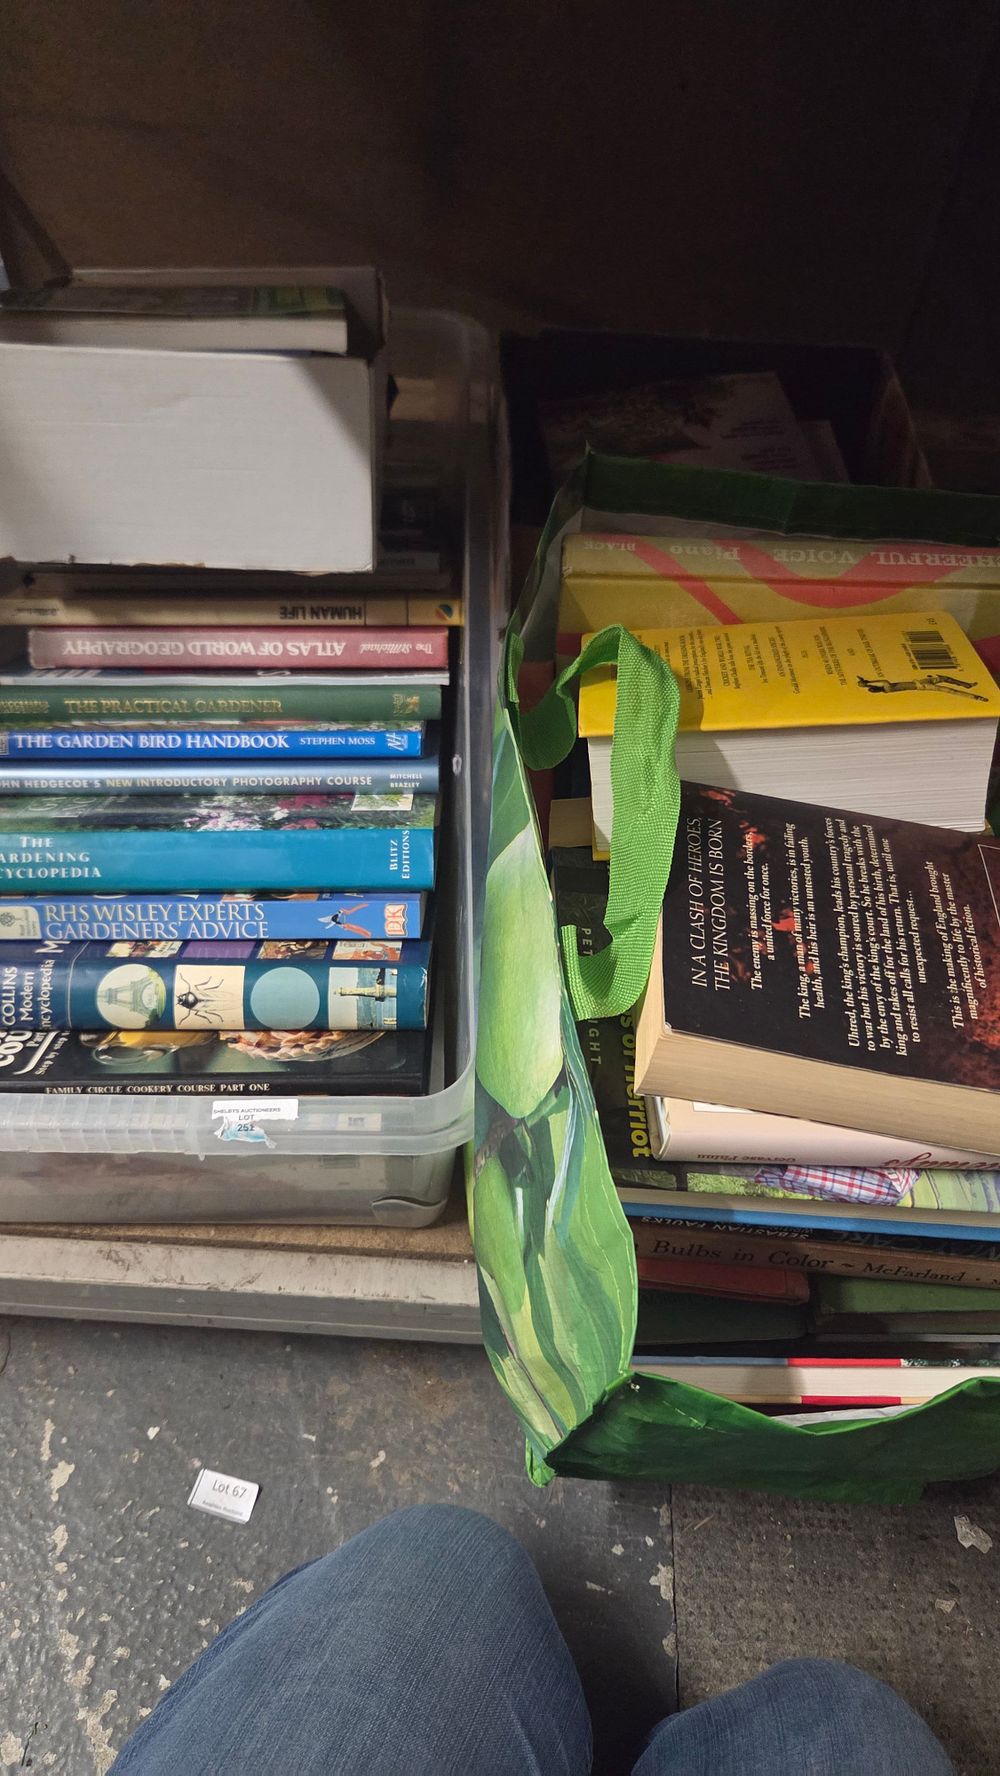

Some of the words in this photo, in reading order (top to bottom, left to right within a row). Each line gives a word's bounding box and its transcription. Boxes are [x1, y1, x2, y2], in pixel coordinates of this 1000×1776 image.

[583, 540, 636, 551] BLACK
[670, 545, 740, 560] Piano
[773, 549, 857, 564] VOICE
[279, 605, 306, 620] LIFE
[307, 605, 363, 620] HUMAN
[62, 640, 184, 656] GEOGRAPHY
[188, 641, 258, 656] WORLD
[259, 641, 284, 656] OF
[287, 641, 346, 656] ATLAS
[416, 643, 434, 655] The
[64, 698, 98, 713] THE
[100, 699, 192, 713] PRACTICAL
[195, 699, 283, 713] GARDENER
[15, 735, 53, 748] THE
[57, 735, 134, 748] GARDEN
[138, 735, 181, 748] BIRD
[186, 734, 290, 748] HANDBOOK
[300, 737, 345, 745] STEPHEN
[348, 737, 376, 745] MOSS
[0, 779, 20, 788] HN
[25, 779, 101, 788] HEDGECOE'S
[106, 779, 132, 788] NEW
[137, 778, 226, 787] INTRODUCTORY
[233, 777, 322, 787] PHOTOGRAPHY
[327, 776, 372, 786] COURSE
[783, 822, 800, 848] failing
[824, 817, 836, 838] forces
[835, 818, 846, 832] and
[852, 824, 865, 837] the
[20, 836, 54, 848] THE
[708, 820, 723, 858] BORN
[797, 836, 813, 862] youth.
[838, 833, 853, 862] tragedy
[853, 838, 863, 855] with
[865, 824, 879, 867] determined
[881, 838, 890, 852] one
[0, 852, 90, 863] ARDENING
[389, 839, 398, 871] BLITZ
[402, 829, 410, 879] EDITIONS
[881, 852, 894, 871] until
[0, 867, 102, 879] YCLOPEDIA
[709, 862, 723, 876] IS
[743, 865, 754, 879] the
[761, 863, 769, 885] once.
[856, 857, 868, 882] breaks
[923, 861, 939, 892] brought
[688, 874, 703, 896] OF
[787, 867, 799, 905] victories,
[799, 863, 813, 899] untested
[830, 876, 841, 889] his
[841, 863, 859, 898] personal
[871, 868, 883, 891] birth,
[941, 872, 954, 900] master
[759, 886, 770, 899] for
[831, 890, 843, 912] leads
[874, 892, 885, 904] his
[888, 883, 899, 904] That
[46, 903, 90, 921] RHS
[93, 903, 172, 921] WISLEY
[176, 903, 265, 921] EXPERTS
[709, 879, 728, 956] KINGDOM
[748, 893, 759, 928] massing
[760, 900, 771, 923] force
[932, 893, 947, 929] England
[946, 901, 957, 915] the
[386, 904, 405, 935] DK
[689, 901, 705, 949] CLASH
[792, 906, 803, 931] many
[847, 911, 861, 941] soured
[864, 909, 875, 935] court.
[877, 917, 890, 937] land
[893, 906, 904, 935] return.
[962, 904, 975, 933] fiction.
[46, 921, 182, 940] GARDENERS'
[187, 921, 269, 939] ADVICE
[761, 924, 774, 953] united
[805, 921, 817, 940] heir
[835, 914, 849, 961] champion,
[950, 928, 963, 942] life
[581, 927, 594, 957] PET
[807, 941, 818, 955] his
[880, 938, 892, 953] the
[895, 937, 907, 950] his
[691, 954, 706, 966] A
[751, 938, 762, 969] enemy
[796, 944, 805, 964] man
[882, 954, 894, 968] for
[897, 951, 909, 966] for
[911, 931, 927, 983] unexpected
[941, 942, 955, 977] making
[968, 934, 984, 978] historical
[713, 960, 730, 990] THE
[808, 956, 821, 974] and
[855, 951, 866, 984] victory
[869, 965, 880, 980] the
[691, 967, 707, 986] IN
[750, 970, 762, 989] The
[797, 973, 809, 996] king,
[884, 970, 896, 985] off
[899, 967, 912, 989] calls
[946, 978, 958, 993] the
[2, 966, 18, 1026] COLLINS
[20, 971, 35, 1021] Modern
[37, 960, 55, 1029] ncyclopedia
[811, 976, 824, 1008] health,
[857, 986, 868, 1000] his
[901, 990, 914, 1002] all
[958, 955, 978, 1019] magnificently
[798, 998, 810, 1018] The
[843, 990, 854, 1006] the
[875, 993, 886, 1016] envy
[887, 986, 900, 1011] takes
[860, 1002, 871, 1019] but
[905, 1003, 918, 1030] resist
[951, 1005, 964, 1028] This
[846, 1009, 859, 1046] Uhtred,
[864, 1020, 873, 1038] war
[876, 1018, 888, 1033] the
[889, 1012, 903, 1031] and
[895, 1032, 908, 1056] king
[46, 1086, 83, 1094] FAMILY
[88, 1085, 122, 1094] CIRCLE
[127, 1085, 172, 1093] COOKERY
[176, 1084, 216, 1092] COURSE
[220, 1083, 245, 1092] PART
[249, 1083, 270, 1091] ONE
[641, 1216, 707, 1228] FAULKS
[712, 1223, 809, 1239] SEBASTIAN
[652, 1239, 722, 1260] Bulbs
[734, 1247, 755, 1262] in
[768, 1249, 834, 1268] Color
[863, 1262, 967, 1281] McFarland
[232, 1484, 248, 1499] 67
